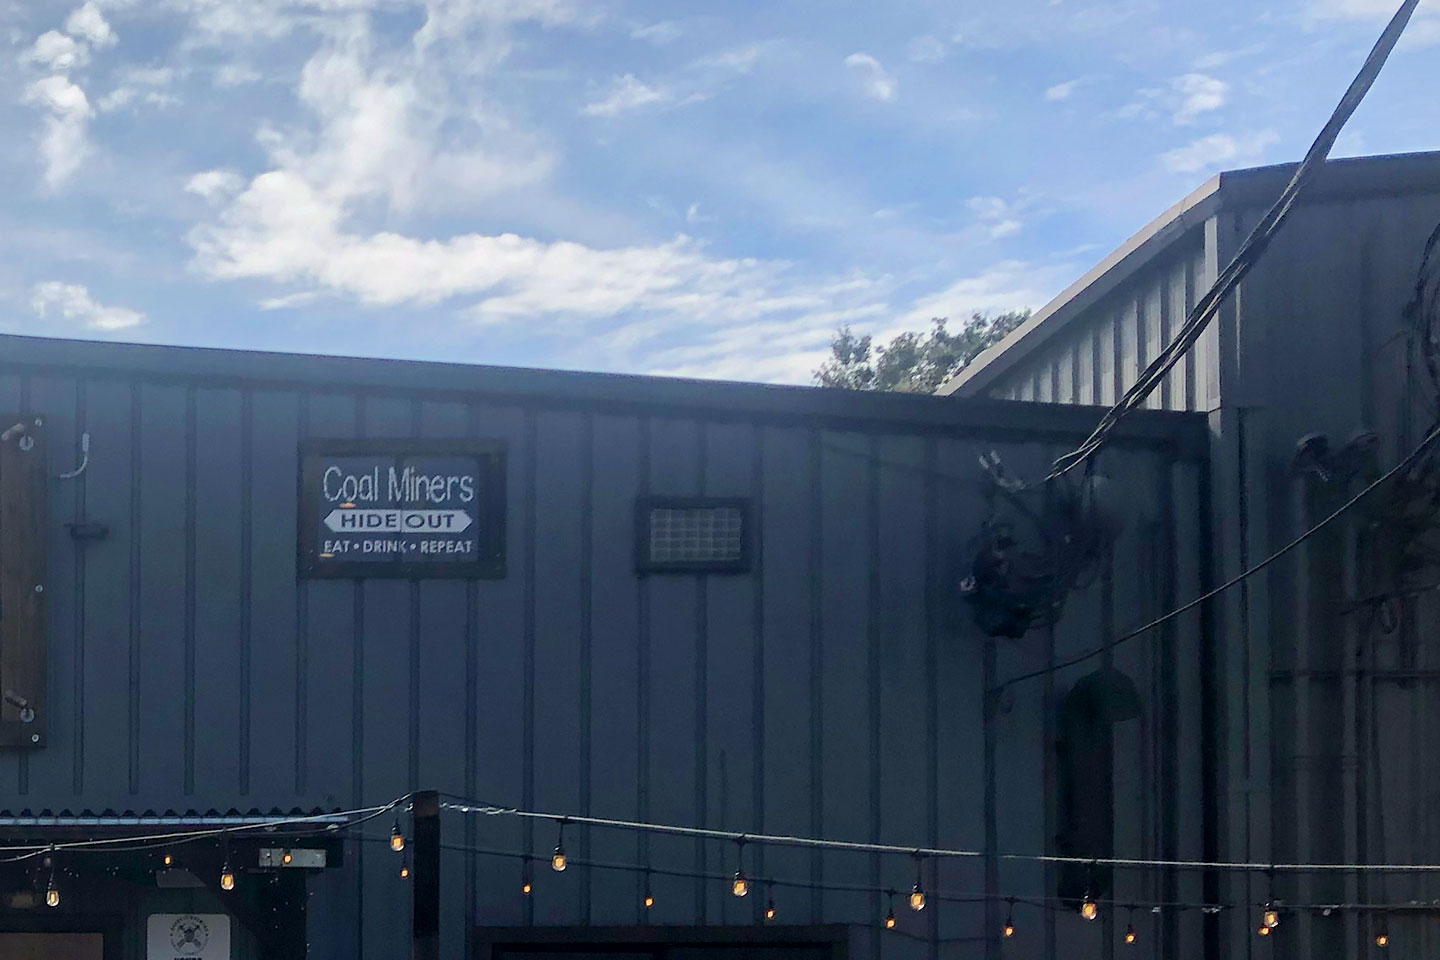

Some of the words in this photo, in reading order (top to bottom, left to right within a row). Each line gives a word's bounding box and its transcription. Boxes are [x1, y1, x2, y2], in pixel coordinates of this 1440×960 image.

[323, 465, 378, 501] Coal
[388, 466, 474, 503] Miners
[323, 540, 350, 553] EAT
[362, 540, 407, 553] DRINK
[420, 540, 473, 554] REPEAT
